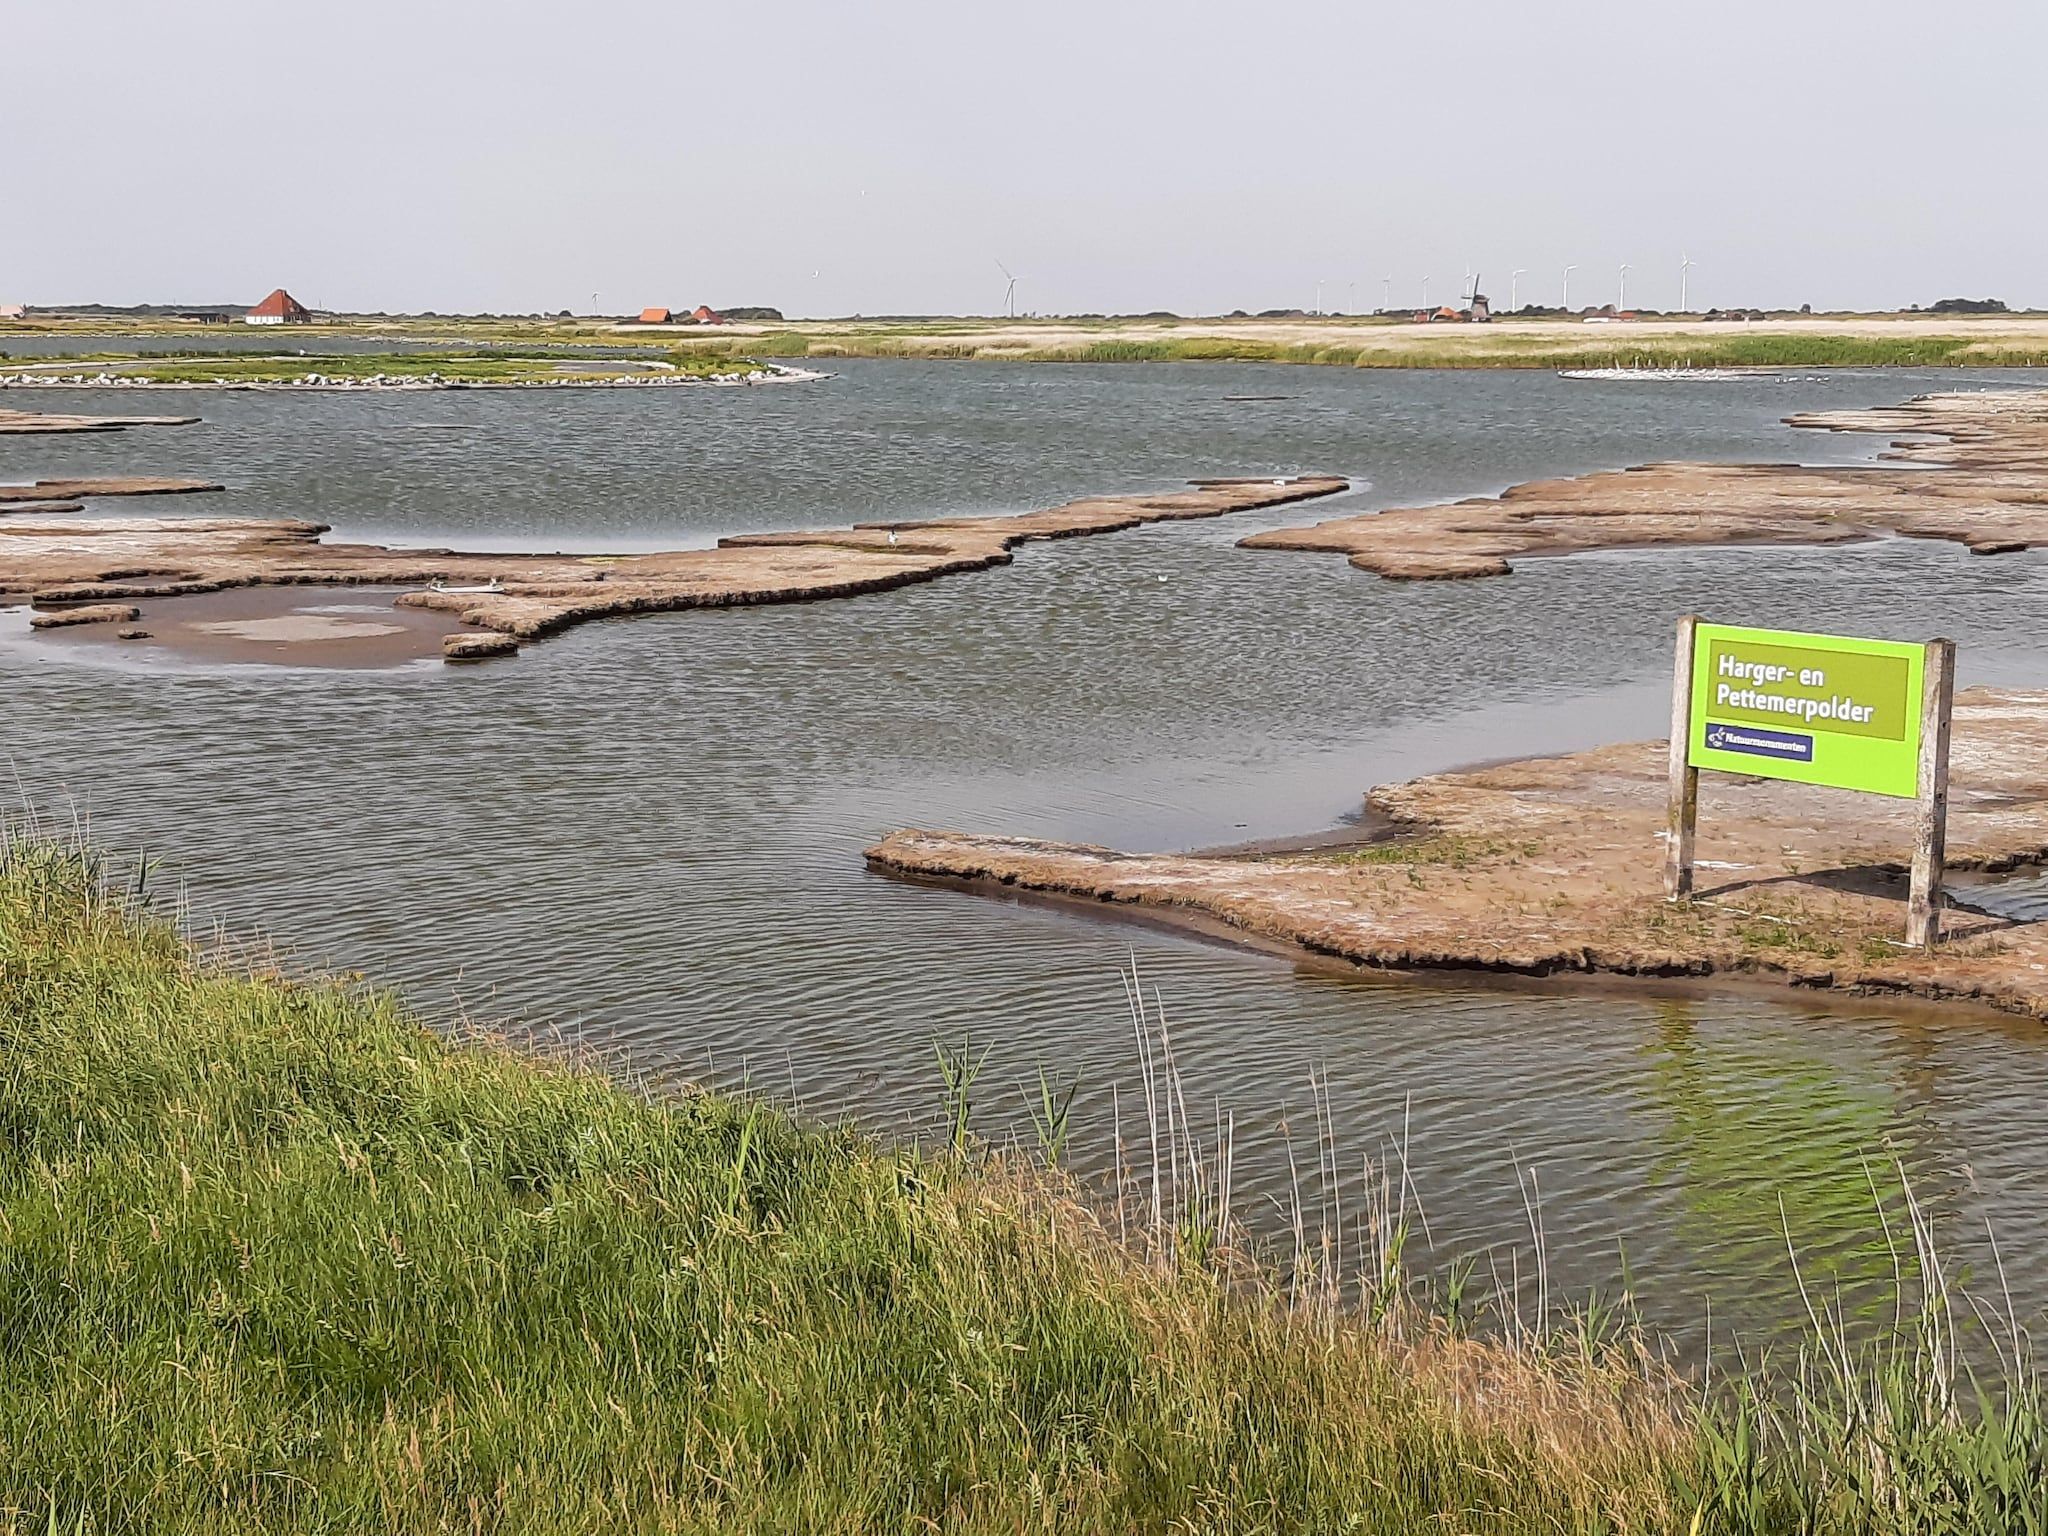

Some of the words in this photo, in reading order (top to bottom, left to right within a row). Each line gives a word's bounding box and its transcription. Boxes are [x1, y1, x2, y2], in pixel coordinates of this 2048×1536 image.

[1718, 654, 1795, 686] Harger-
[1799, 667, 1824, 686] en
[1716, 683, 1874, 723] Pettemerpolder
